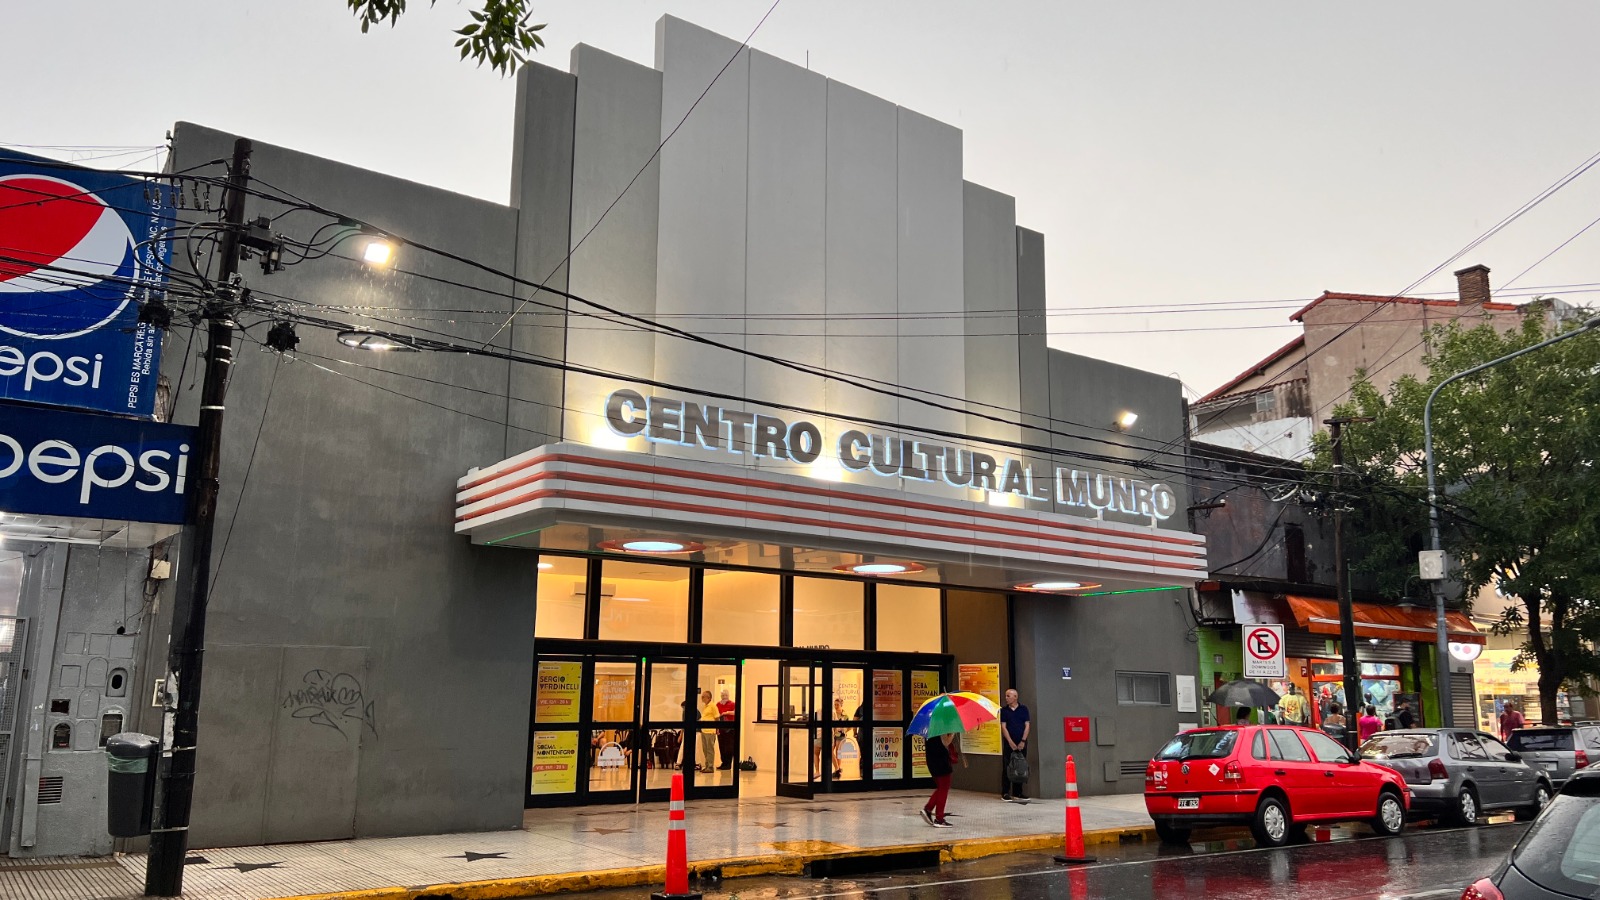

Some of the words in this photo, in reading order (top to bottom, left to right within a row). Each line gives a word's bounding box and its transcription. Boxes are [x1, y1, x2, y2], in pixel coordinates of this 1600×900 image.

[146, 336, 154, 348] sin
[132, 344, 143, 370] MARCA
[141, 348, 153, 375] Bebida
[131, 371, 140, 383] ES
[128, 385, 139, 408] PEPSI
[604, 388, 823, 465] CENTRO
[837, 429, 1048, 501] CULTURAL
[1055, 466, 1177, 520] MUNRO
